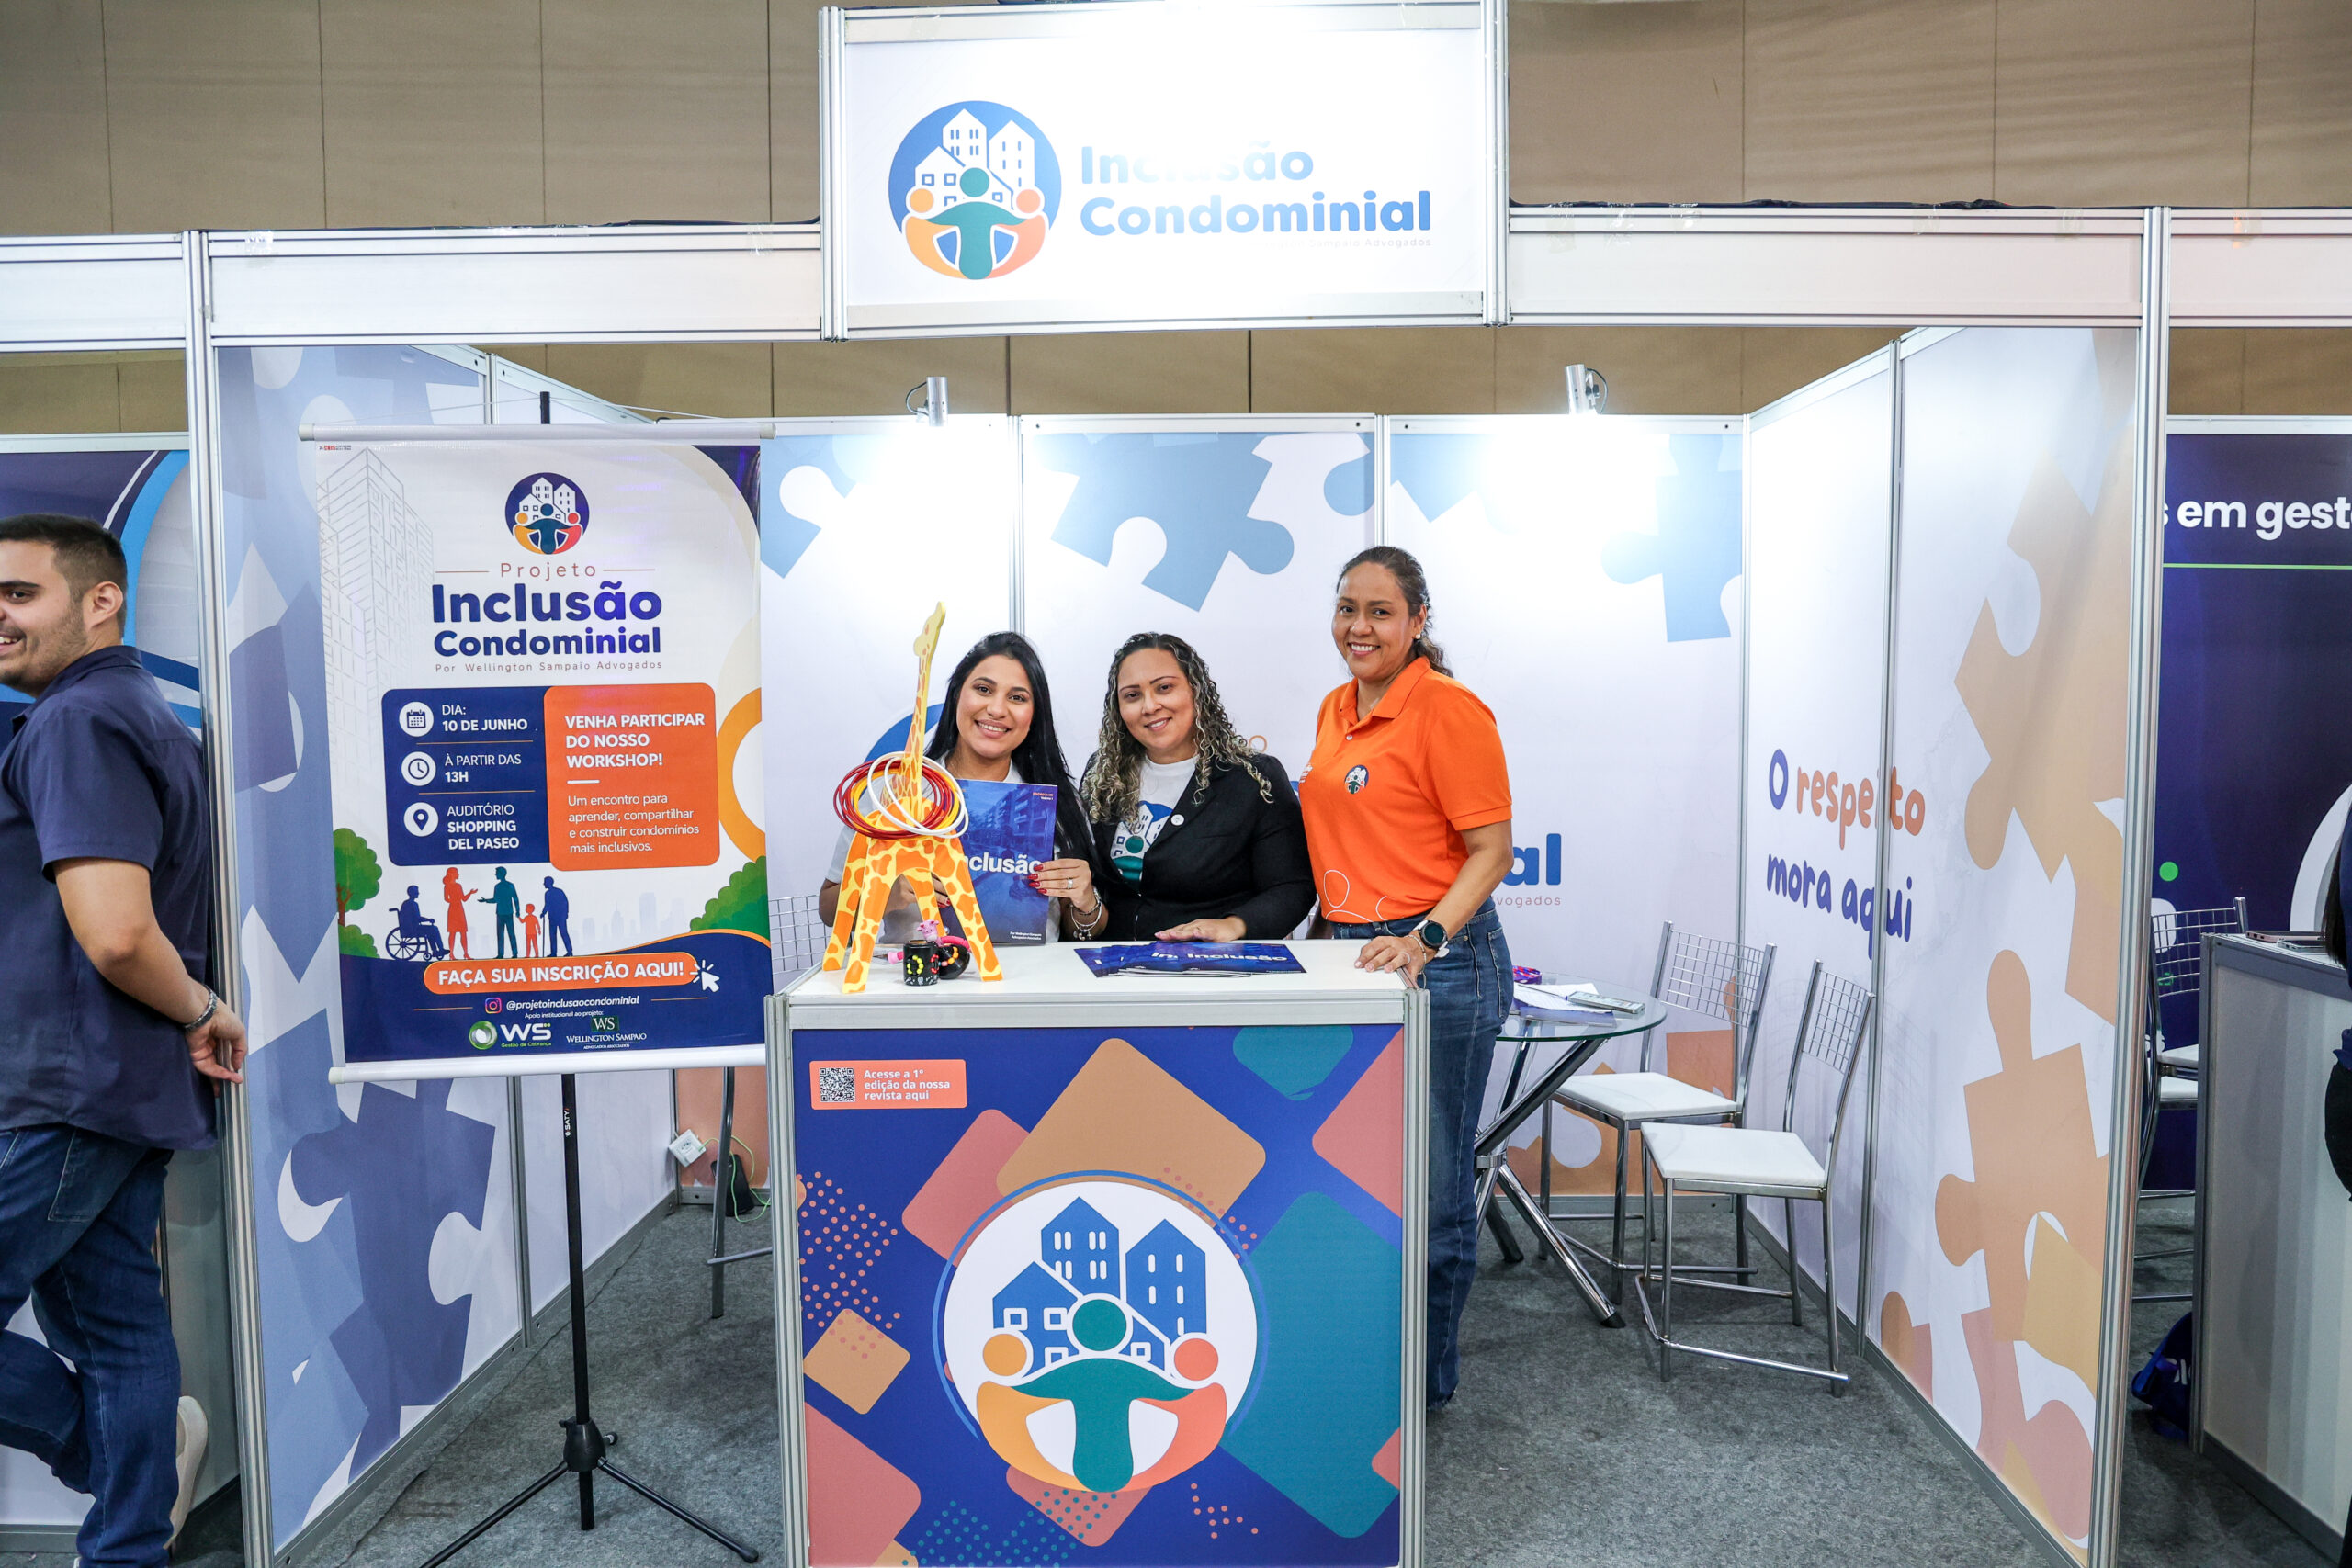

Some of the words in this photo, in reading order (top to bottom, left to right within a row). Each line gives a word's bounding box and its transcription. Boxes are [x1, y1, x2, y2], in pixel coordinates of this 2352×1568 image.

[1080, 189, 1431, 236] Condominial
[1365, 238, 1431, 249] Advogados
[2177, 501, 2247, 528] em
[2256, 496, 2352, 541] gest
[501, 562, 597, 581] Projeto
[432, 581, 662, 623] Inclusão
[434, 626, 662, 657] Condominial
[435, 663, 456, 672] Por
[465, 661, 533, 675] Wellington
[539, 660, 591, 673] Sampaio
[596, 660, 662, 672] Advogados
[442, 705, 467, 716] DIA:
[442, 720, 458, 732] 10
[461, 720, 480, 732] DE
[481, 718, 528, 731] JUNHO
[565, 715, 617, 728] VENHA
[621, 713, 705, 728] PARTICIPAR
[566, 735, 590, 749] DO
[594, 733, 650, 748] NOSSO
[445, 754, 454, 767] À
[457, 754, 496, 766] PARTIR
[498, 754, 522, 765] DAS
[566, 752, 663, 768] WORKSHOP!
[445, 771, 469, 783] 13H
[568, 795, 588, 807] Um
[591, 794, 640, 806] encontro
[643, 795, 668, 807] para
[1769, 749, 1789, 810] O
[1796, 765, 1926, 851] respeto
[447, 802, 514, 817] AUDITÓRIO
[569, 811, 622, 824] aprender,
[624, 808, 694, 823] compartilhar
[447, 820, 517, 834] SHOPPING
[579, 826, 627, 838] construir
[629, 824, 699, 837] condomínios
[448, 838, 474, 851] DEL
[477, 837, 520, 850] PASEO
[570, 842, 595, 854] mais
[598, 840, 653, 853] inclusivos.
[1766, 853, 1832, 914] mora
[1841, 876, 1912, 961] aqui
[438, 970, 487, 988] FAÇA
[491, 967, 527, 984] SUA
[531, 960, 629, 984] INSCRIÇÃO
[634, 961, 684, 978] AQUI!
[506, 995, 640, 1012] @projetoinclusaocondominial
[500, 1022, 551, 1041] WS
[593, 1017, 615, 1031] WS
[566, 1034, 615, 1043] WELLINGTON
[616, 1032, 647, 1042] SAMPAIO
[864, 1070, 900, 1079] Acesse
[864, 1079, 900, 1092] edição
[902, 1079, 916, 1089] da
[919, 1080, 951, 1089] nossa
[865, 1090, 903, 1100] revista
[905, 1089, 930, 1102] aqui
